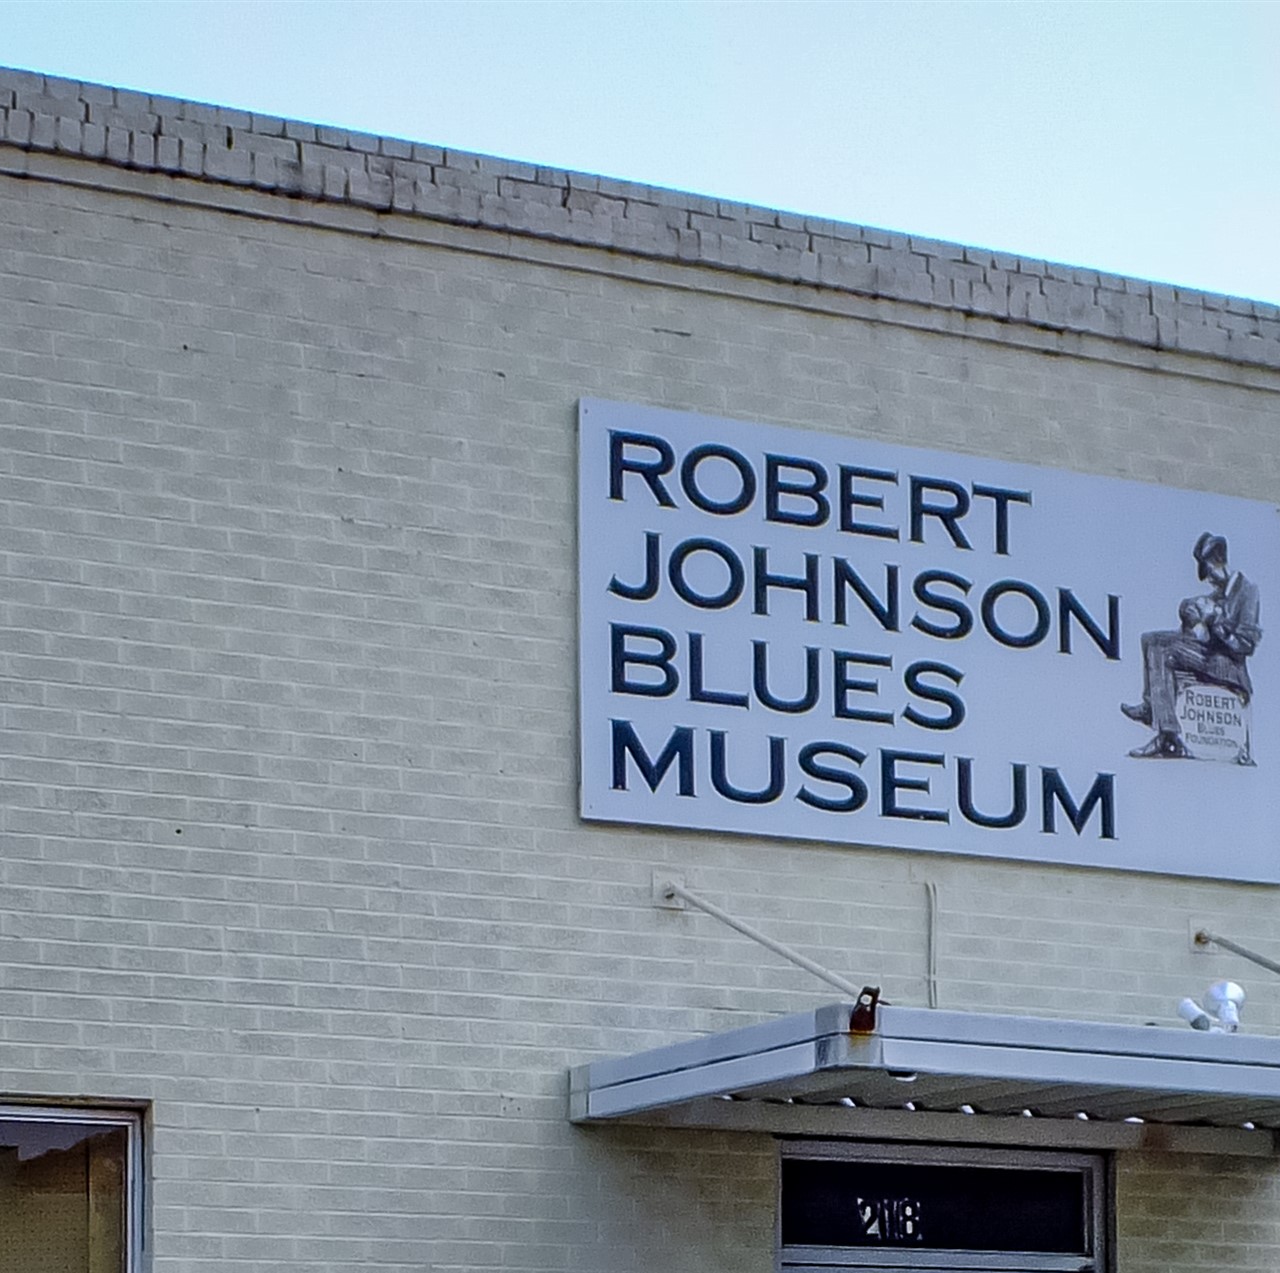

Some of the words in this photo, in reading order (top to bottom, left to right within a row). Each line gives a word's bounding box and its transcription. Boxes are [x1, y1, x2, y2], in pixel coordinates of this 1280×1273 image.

[608, 429, 1033, 557] ROBERT
[607, 532, 1122, 661] JOHNSON
[609, 622, 967, 731] BLUES
[1180, 705, 1242, 727] JOHNSON
[1185, 689, 1237, 710] ROBERT
[610, 719, 1118, 841] MUSEUM
